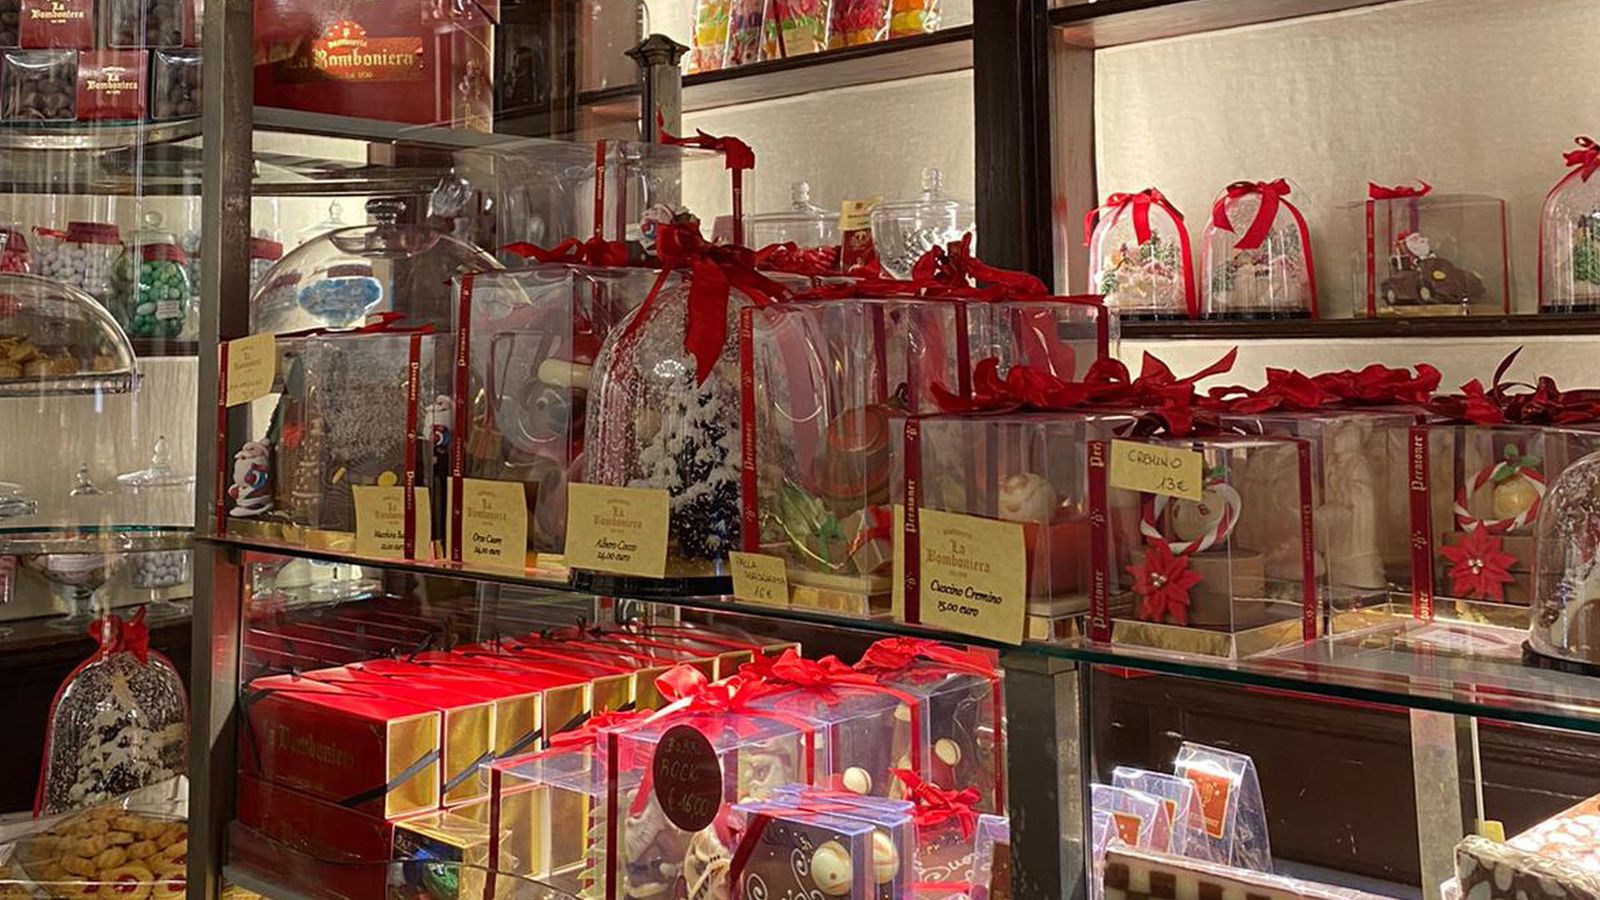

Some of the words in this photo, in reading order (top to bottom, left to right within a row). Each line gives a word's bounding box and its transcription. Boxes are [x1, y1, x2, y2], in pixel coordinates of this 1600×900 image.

[1413, 434, 1428, 492] Peratoner
[950, 539, 966, 555] La
[927, 548, 990, 573] Bomboniera
[930, 579, 964, 597] Cuscino
[965, 586, 1003, 605] Cremino
[959, 605, 979, 617] euro
